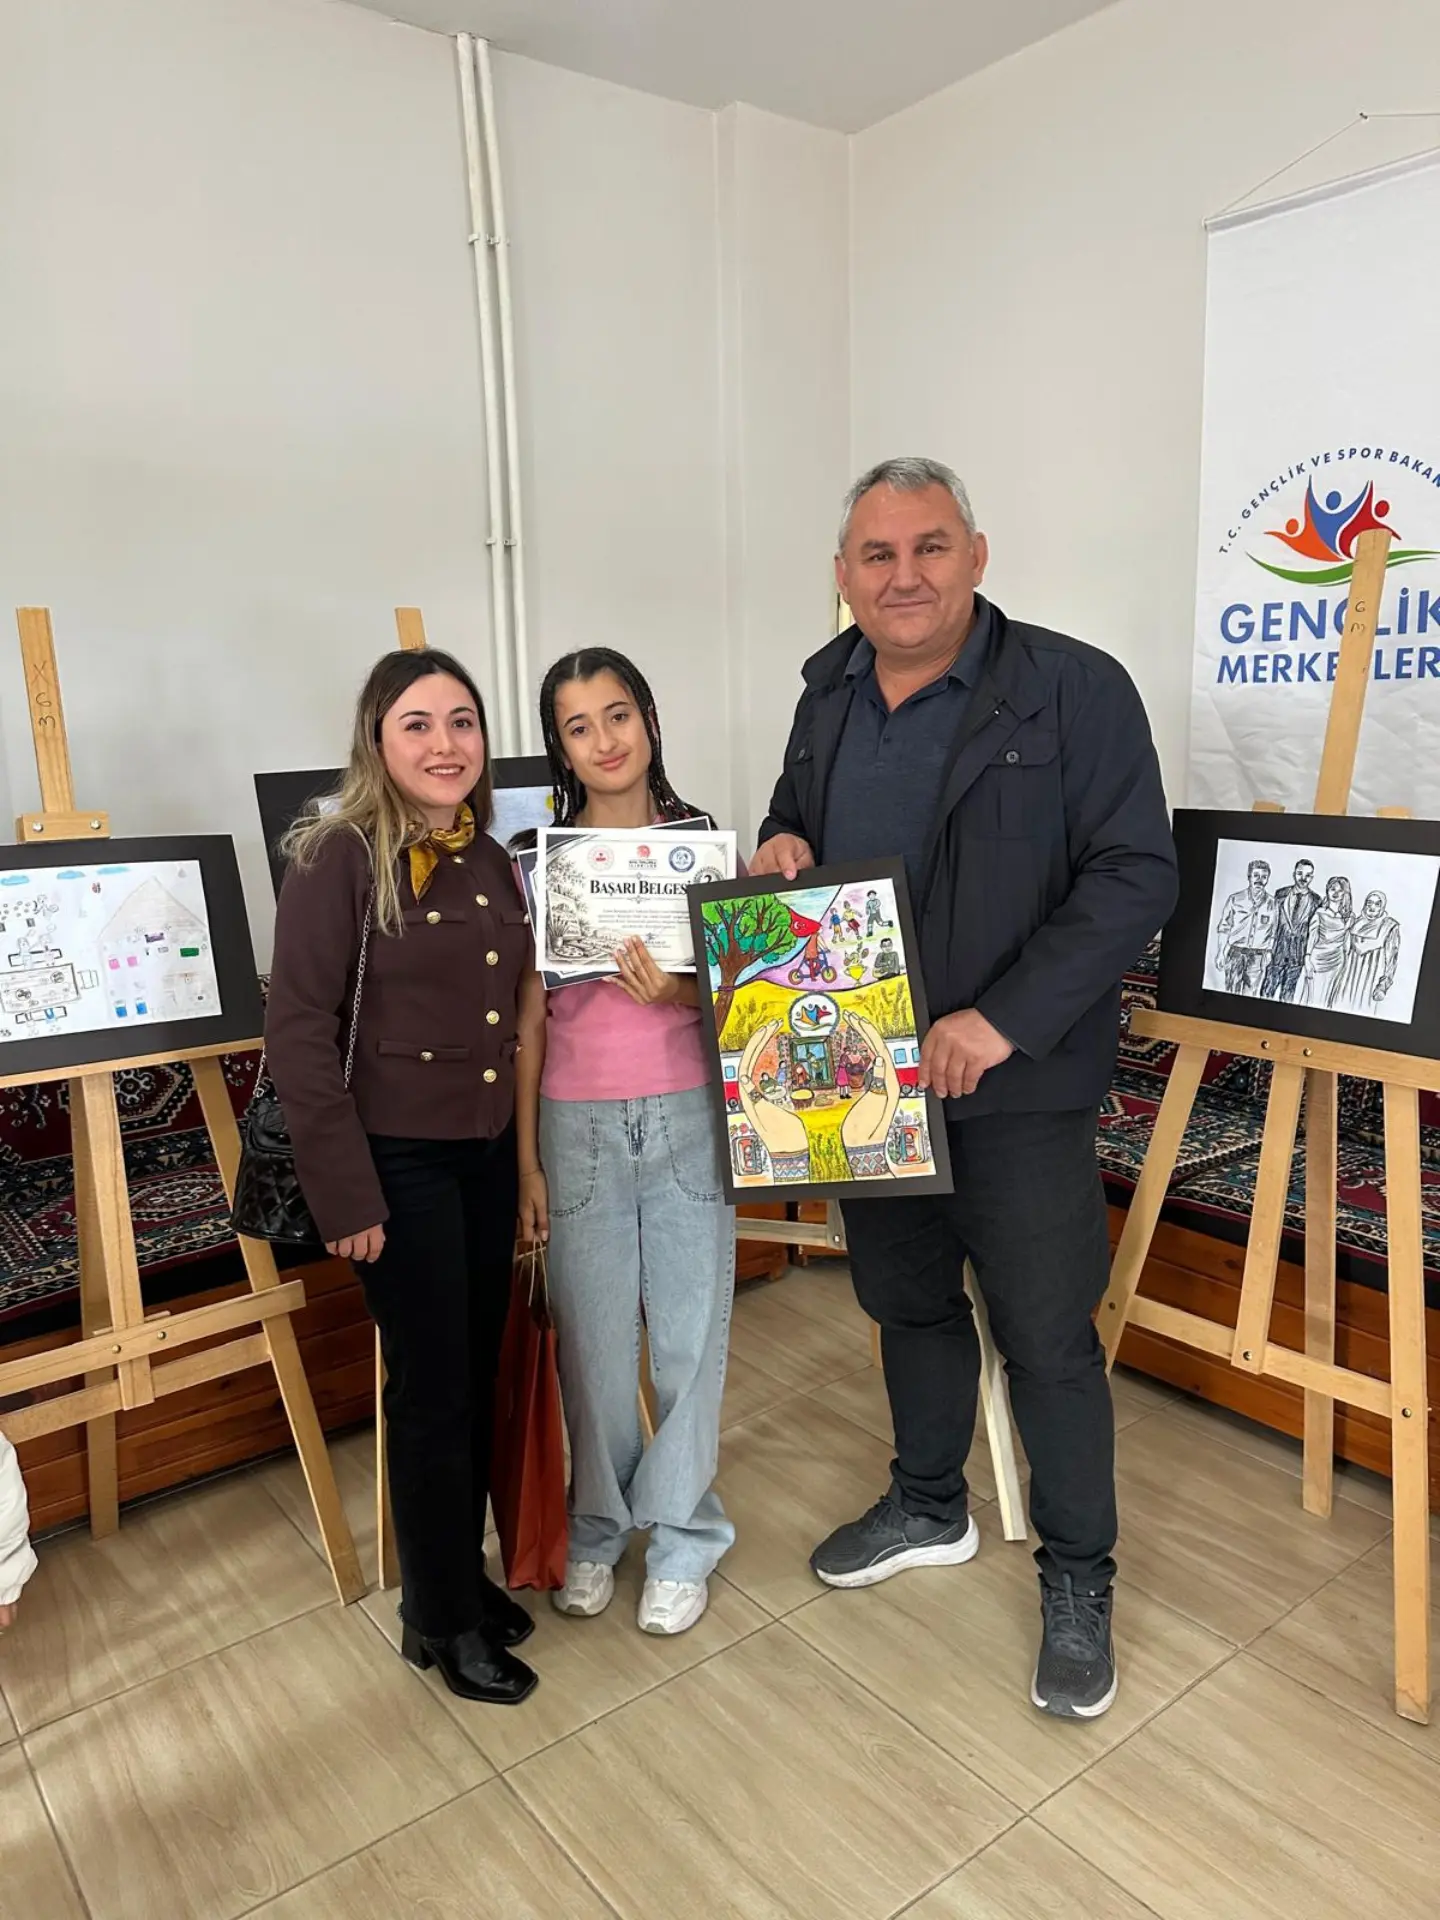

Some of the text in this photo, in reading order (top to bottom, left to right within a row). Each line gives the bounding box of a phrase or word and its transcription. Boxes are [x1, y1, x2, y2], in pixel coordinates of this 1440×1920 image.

[1219, 525, 1243, 554] T.C.
[1241, 462, 1307, 520] GENÇLİK
[1310, 451, 1332, 467] VE
[1337, 447, 1383, 461] SPOR
[1217, 646, 1440, 684] MERKELER
[590, 880, 636, 896] BAŞARI
